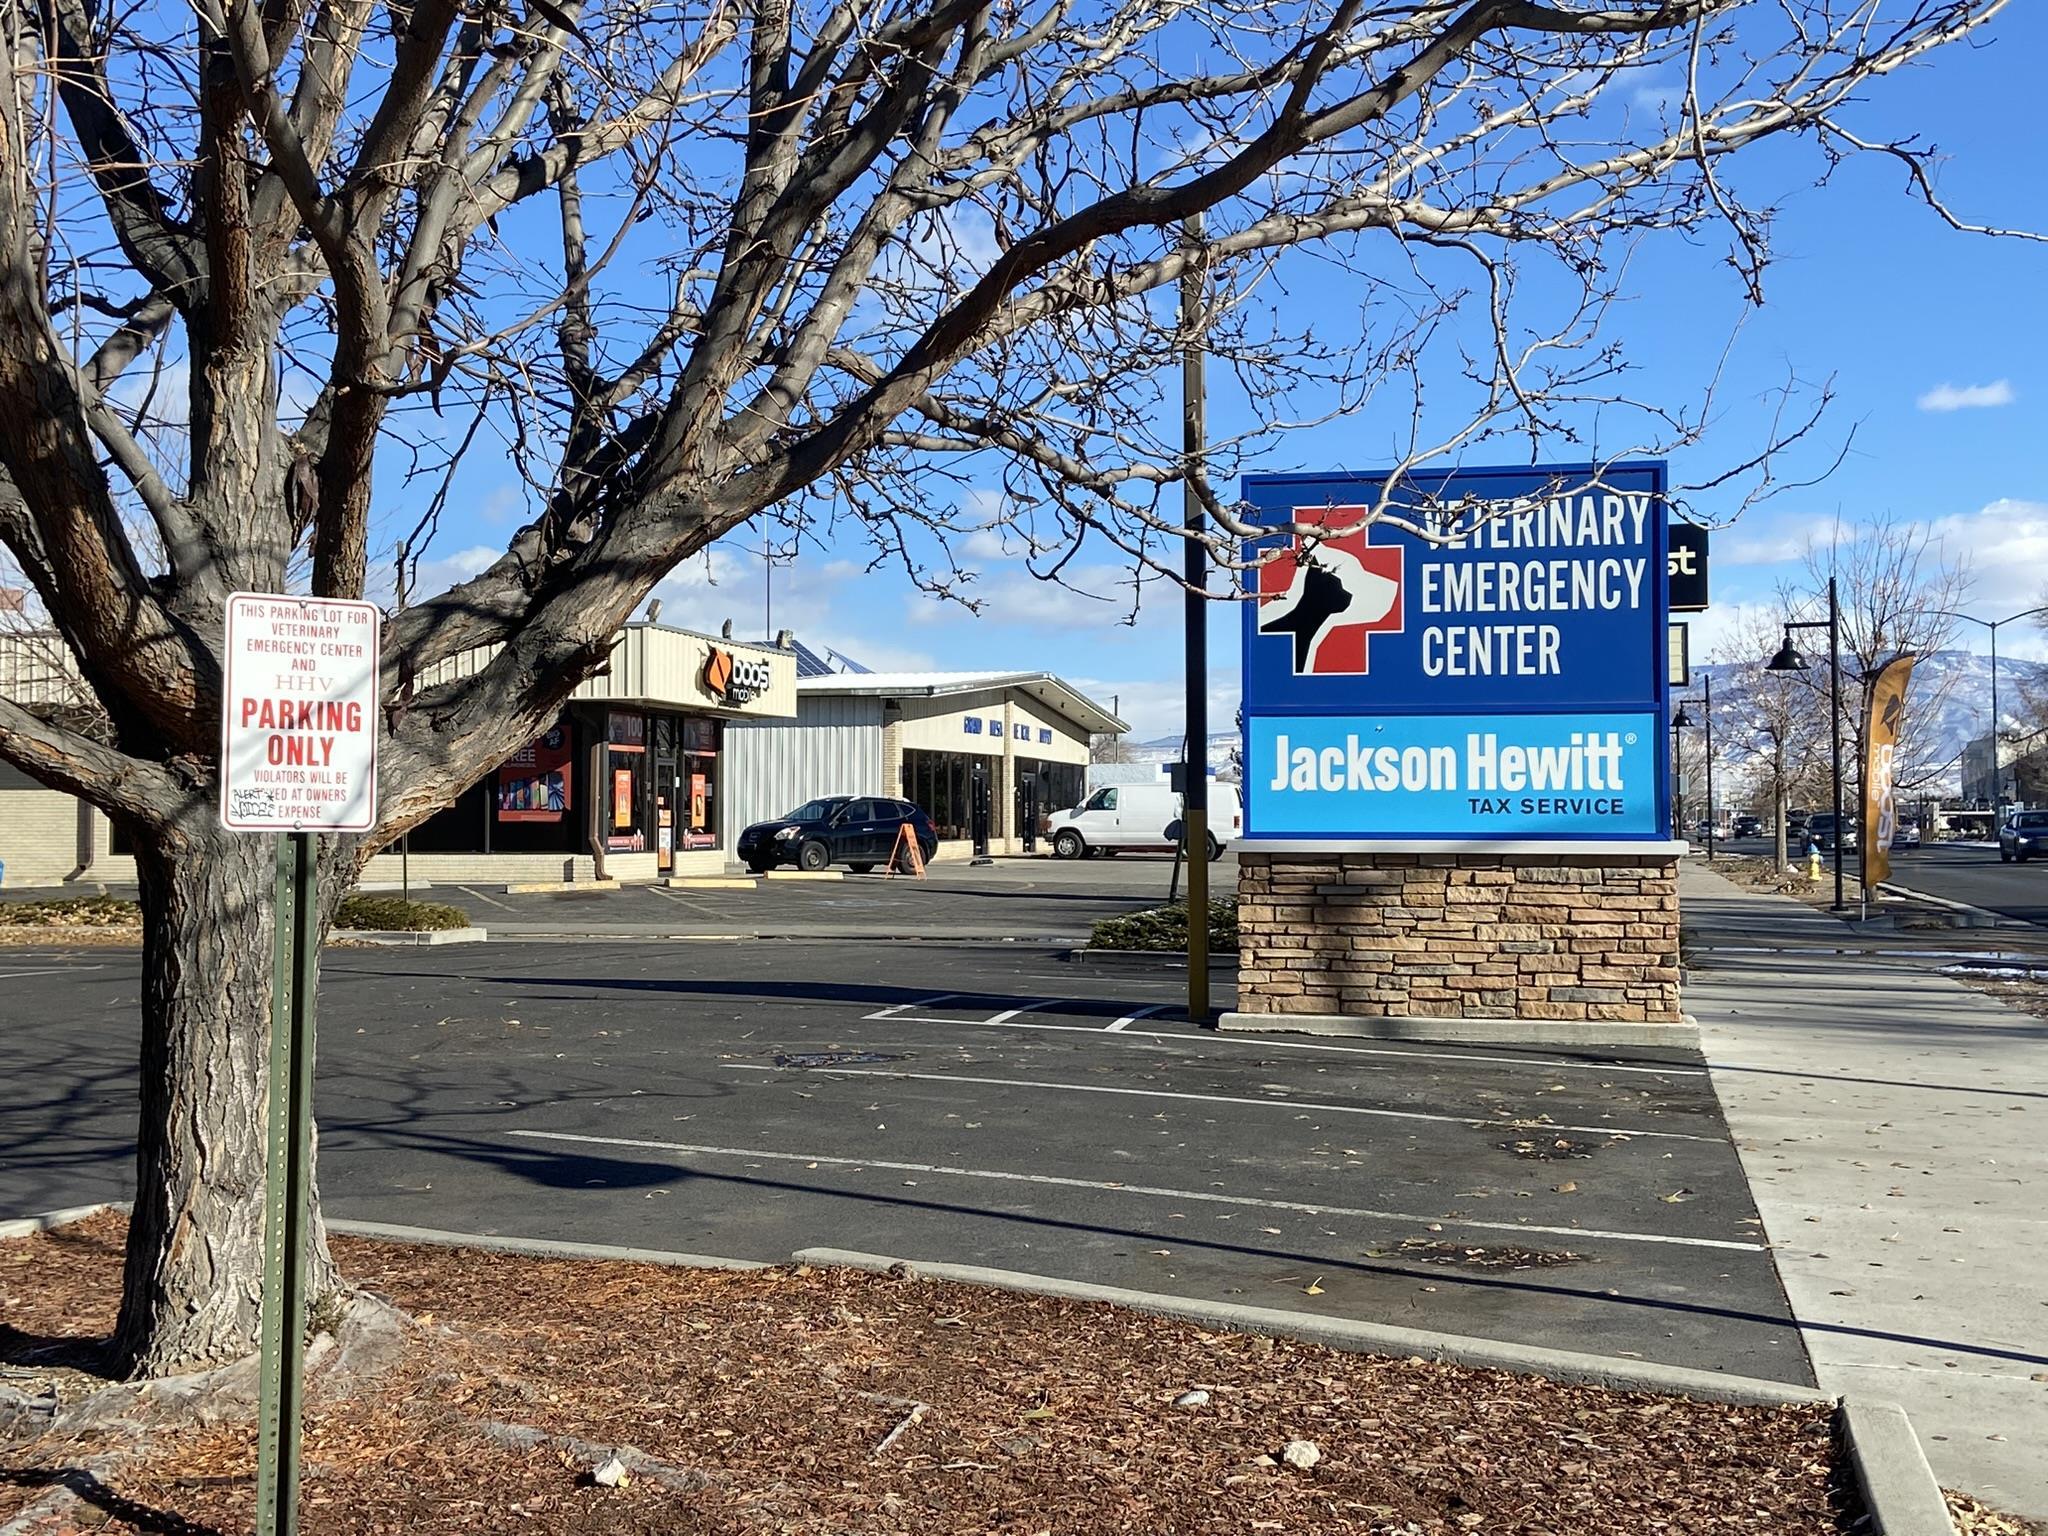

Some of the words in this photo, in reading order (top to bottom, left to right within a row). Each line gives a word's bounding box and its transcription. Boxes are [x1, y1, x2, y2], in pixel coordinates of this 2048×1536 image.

[1421, 558, 1647, 613] EMERGENCY
[239, 603, 265, 618] THIS
[270, 606, 319, 622] PARKING
[323, 609, 343, 623] LOT
[347, 611, 368, 625] FOR
[271, 623, 340, 639] VETERINARY
[246, 638, 316, 656] EMERGENCY
[320, 643, 363, 658] CENTER
[1422, 624, 1562, 677] CENTER
[291, 658, 316, 672] AND
[274, 674, 335, 692] HHV
[241, 697, 362, 733] PARKING
[267, 734, 335, 767] ONLY
[1271, 734, 1457, 793] Jackson
[254, 769, 306, 784] VIOLATORS
[309, 771, 332, 784] WILL
[335, 772, 348, 785] BE
[292, 788, 303, 801] AT
[306, 788, 347, 802] OWNERS
[278, 805, 321, 819] EXPENSE
[1468, 799, 1512, 815] TAX
[1520, 798, 1625, 816] SERVICE
